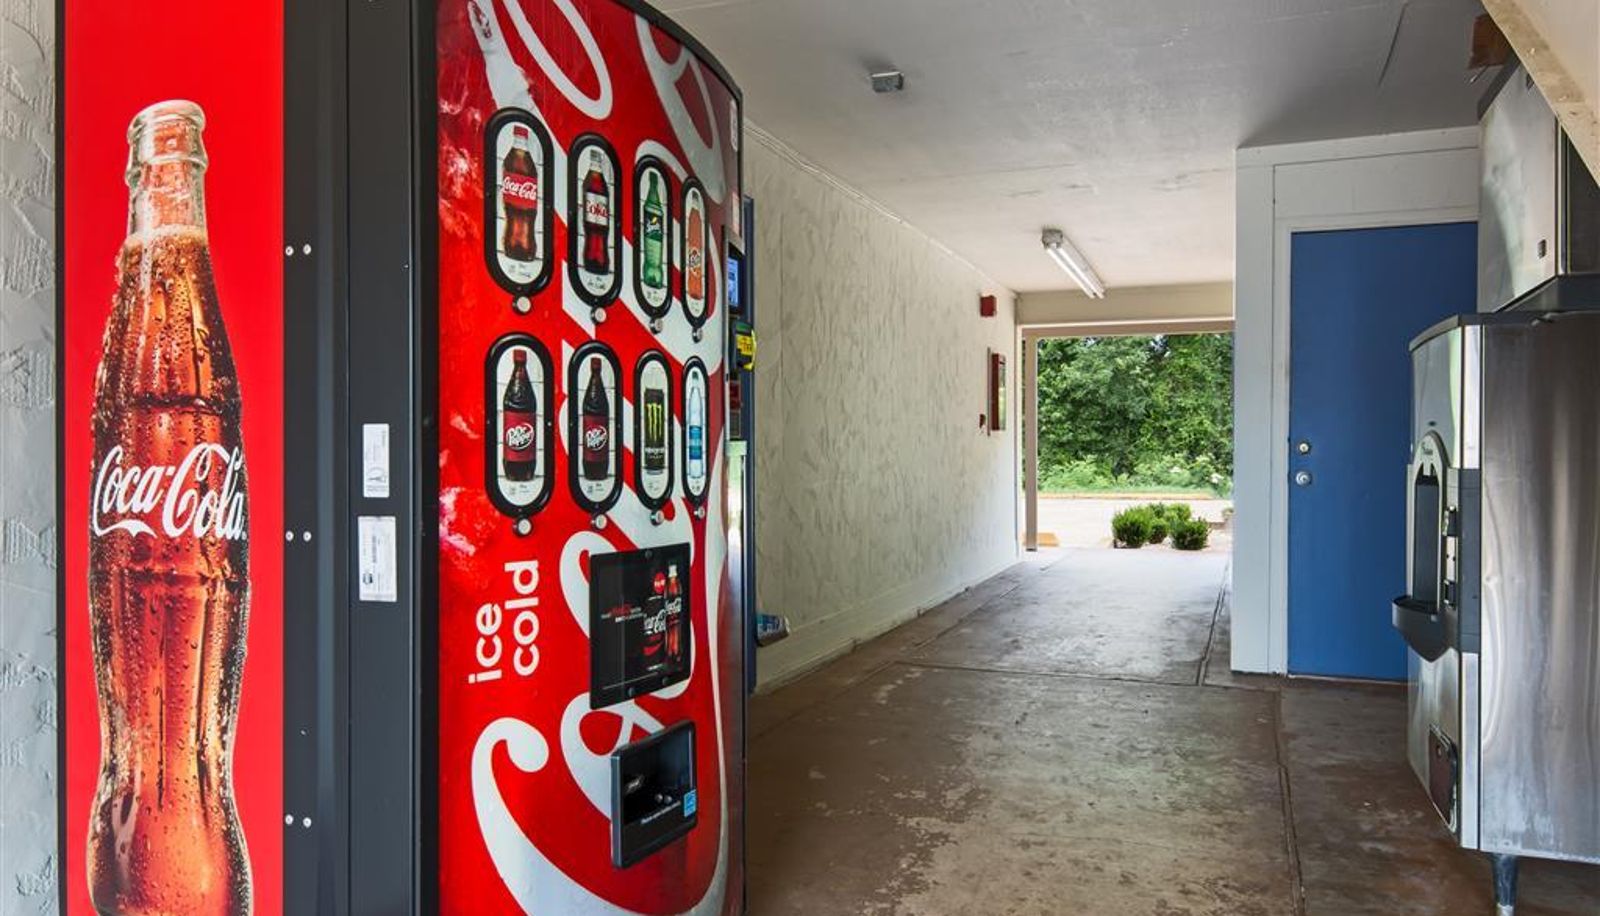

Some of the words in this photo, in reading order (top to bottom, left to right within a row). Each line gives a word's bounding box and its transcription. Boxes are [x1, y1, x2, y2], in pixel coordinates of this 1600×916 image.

[502, 175, 537, 201] Coca-Cola
[93, 442, 245, 540] Coca-Cola
[468, 603, 502, 684] ice
[504, 559, 540, 676] cold
